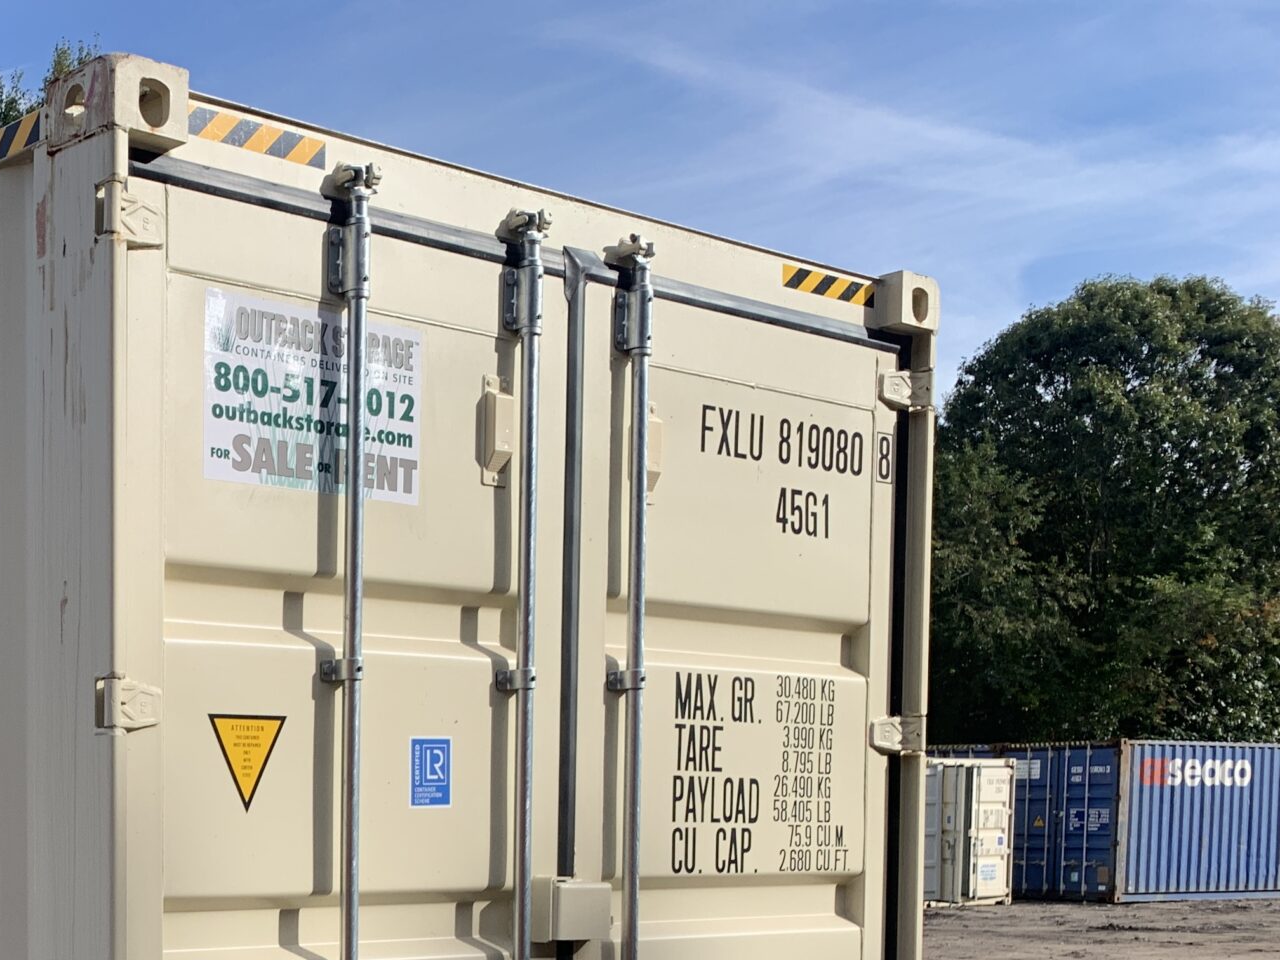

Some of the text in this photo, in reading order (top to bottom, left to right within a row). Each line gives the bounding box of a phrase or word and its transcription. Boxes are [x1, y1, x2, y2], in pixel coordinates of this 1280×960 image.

[235, 306, 414, 372] OUTBACK SRAGE
[214, 362, 415, 423] 800-517-012
[393, 374, 414, 386] SITE
[212, 401, 413, 448] outbackstorae.com
[701, 403, 891, 480] FXLU 819080 8
[210, 447, 230, 460] FOR
[232, 434, 313, 480] SALE
[317, 462, 331, 474] OR
[776, 487, 829, 539] 45G1
[675, 671, 762, 724] MAX. GR.
[820, 678, 835, 702] KG
[820, 703, 834, 726] LB
[675, 723, 724, 772] TARE
[819, 727, 833, 750] KG
[427, 749, 444, 779] LR
[818, 752, 832, 775] LB
[672, 775, 760, 824] PAYLOAD
[817, 776, 831, 799] KG
[817, 800, 831, 823] LB
[671, 827, 758, 874] CU. CAP.
[787, 825, 812, 848] 75.9
